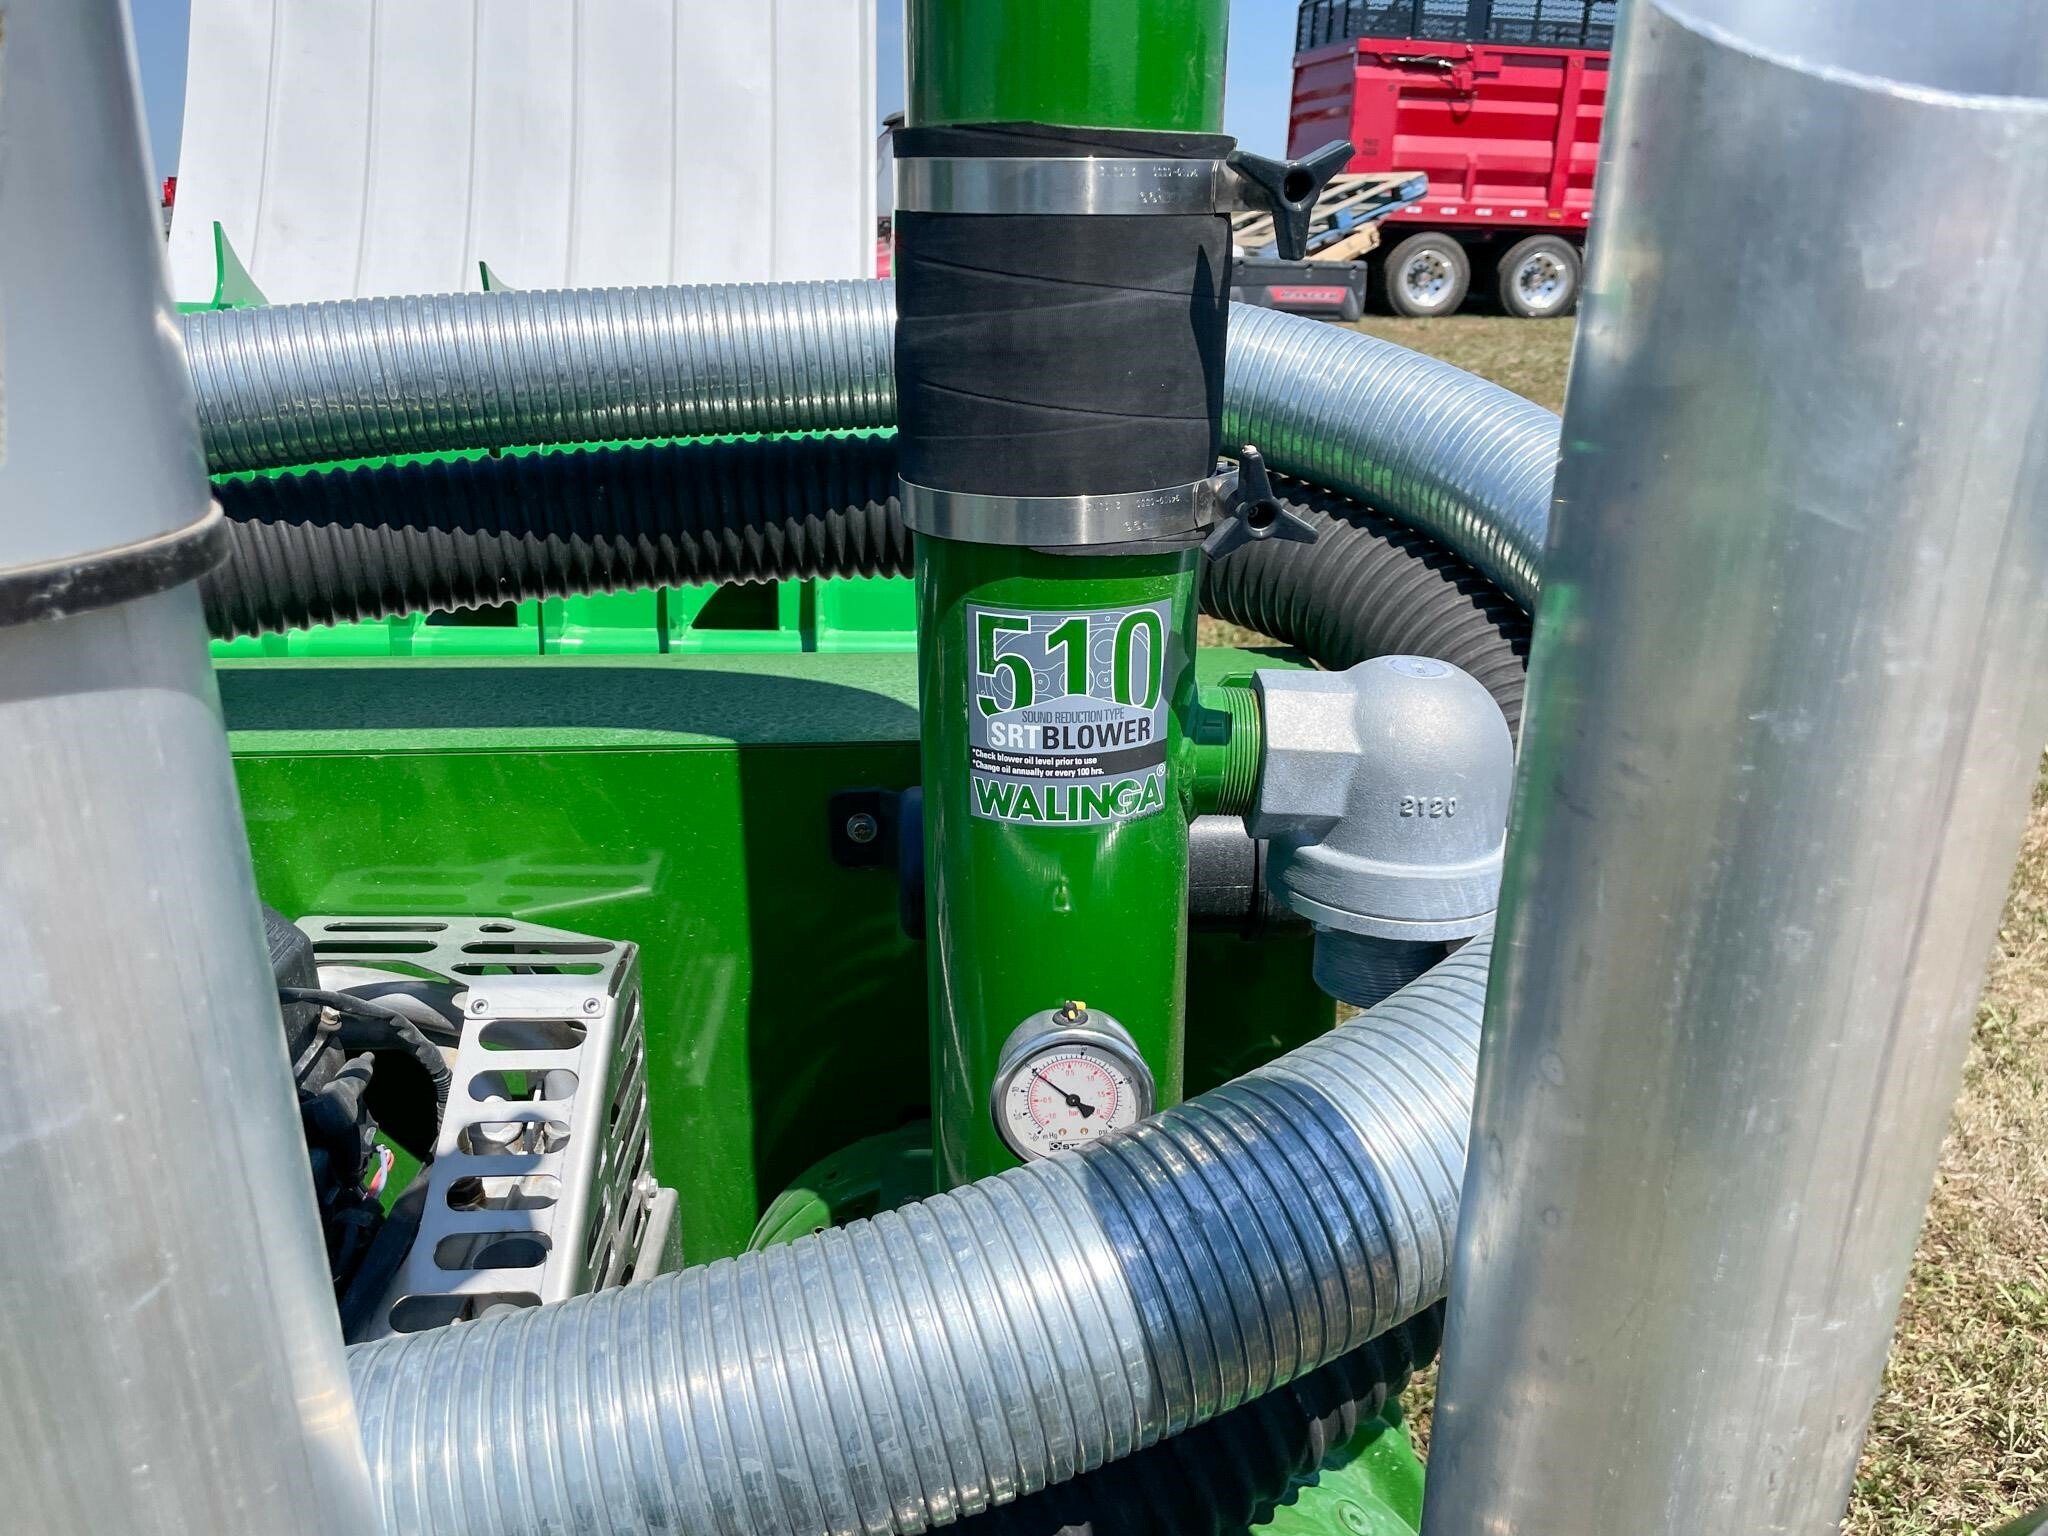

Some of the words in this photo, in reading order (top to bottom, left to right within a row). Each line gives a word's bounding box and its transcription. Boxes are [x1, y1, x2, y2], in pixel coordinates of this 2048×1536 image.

[976, 609, 1164, 719] 510
[1022, 710, 1053, 723] SOUND
[1055, 710, 1102, 723] REDUCTION
[1104, 707, 1124, 720] TYPE
[997, 754, 1023, 764] blower
[1024, 755, 1034, 765] oil
[1035, 756, 1054, 766] level
[1055, 757, 1073, 768] prior
[1074, 756, 1082, 765] to
[1084, 757, 1098, 765] use
[1001, 764, 1011, 774] oil
[1012, 766, 1044, 778] annually
[1045, 768, 1053, 777] or
[1054, 769, 1076, 778] every
[1077, 768, 1089, 776] 100
[1091, 766, 1104, 775] hrs.
[1399, 797, 1457, 819] 2120
